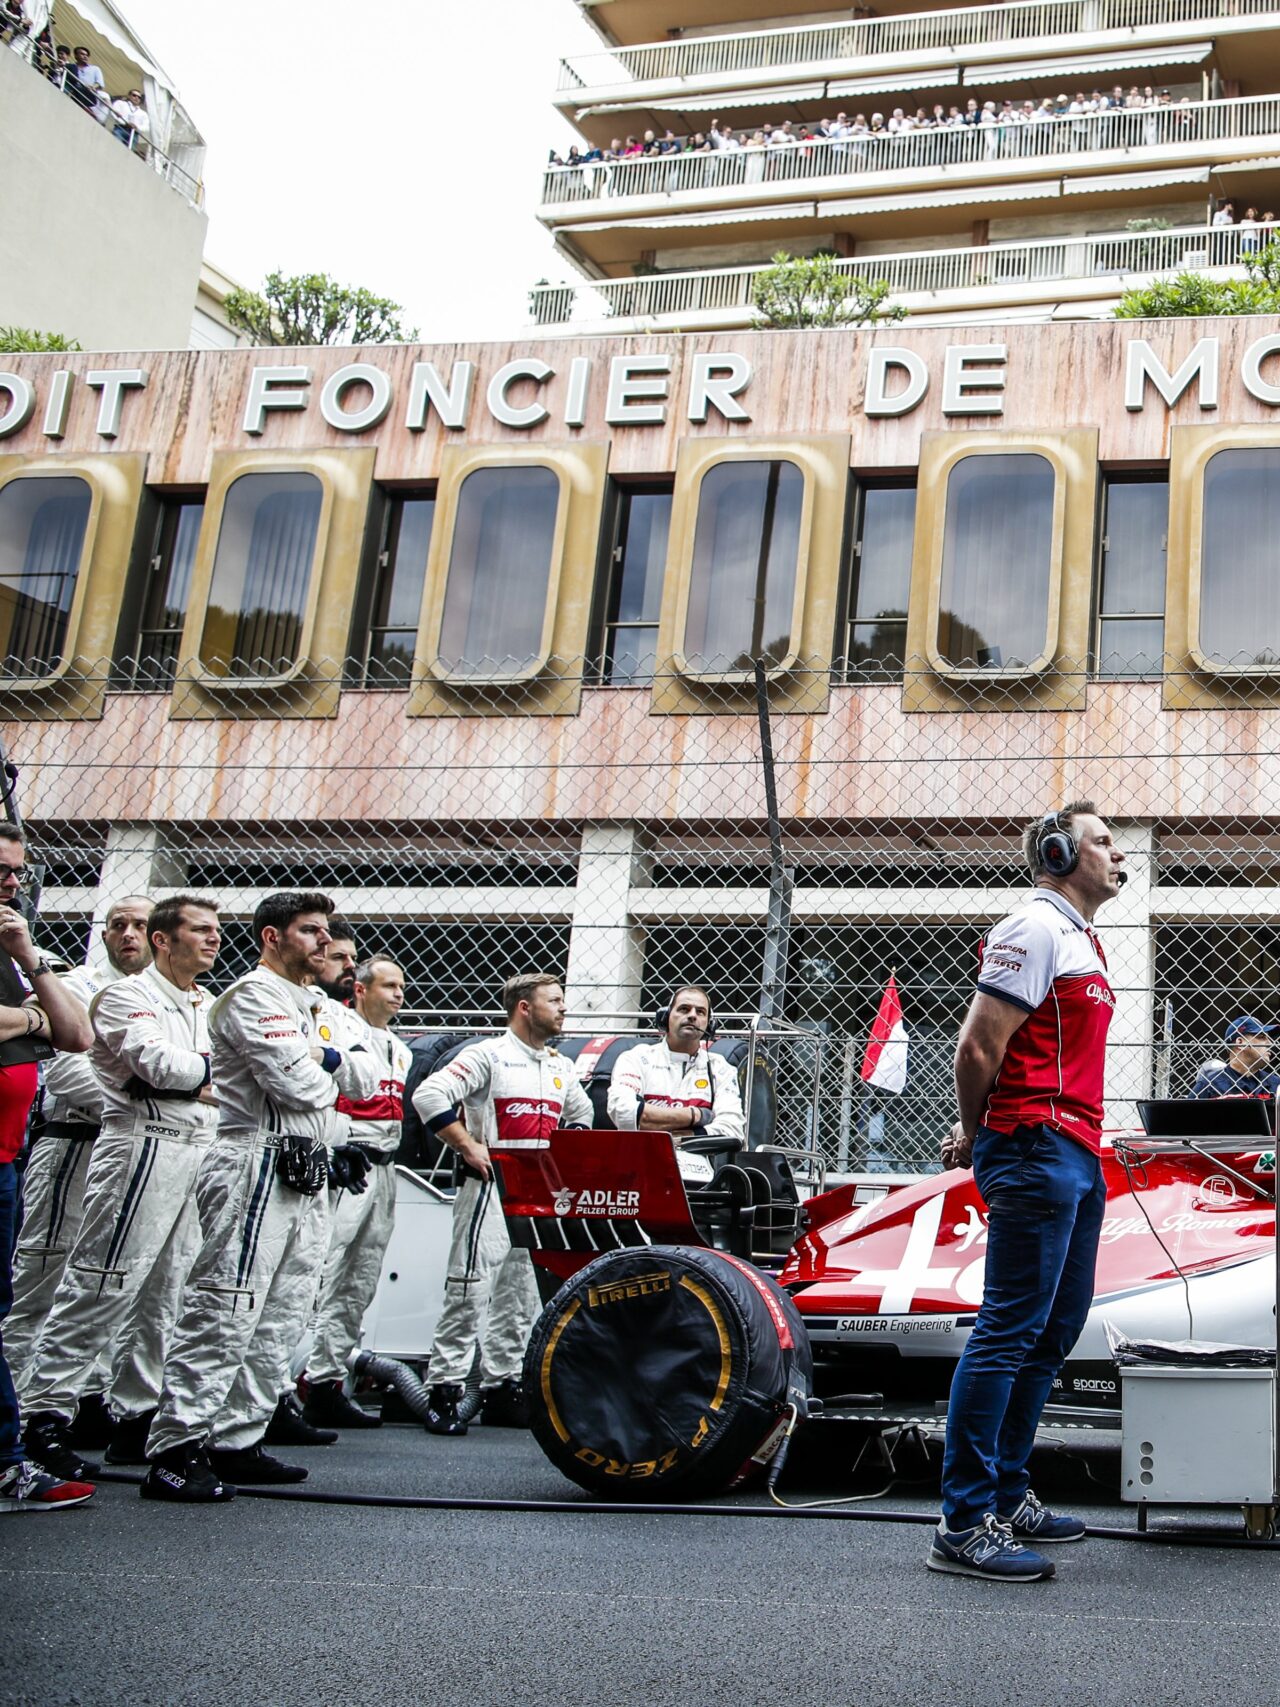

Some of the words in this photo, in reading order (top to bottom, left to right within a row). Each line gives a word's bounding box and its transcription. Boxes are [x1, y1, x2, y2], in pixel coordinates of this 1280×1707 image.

[242, 352, 753, 436] FONCIER
[863, 343, 1007, 418] DE
[991, 943, 1027, 957] CARRERA
[144, 1124, 180, 1137] sparco
[577, 1190, 640, 1206] ADLER
[1152, 1213, 1260, 1234] Romeo
[588, 1271, 671, 1308] PIRELLI
[840, 1320, 888, 1331] SAUBER
[890, 1318, 953, 1334] Engineering
[1073, 1378, 1116, 1392] sparco
[575, 1448, 678, 1480] ZERO
